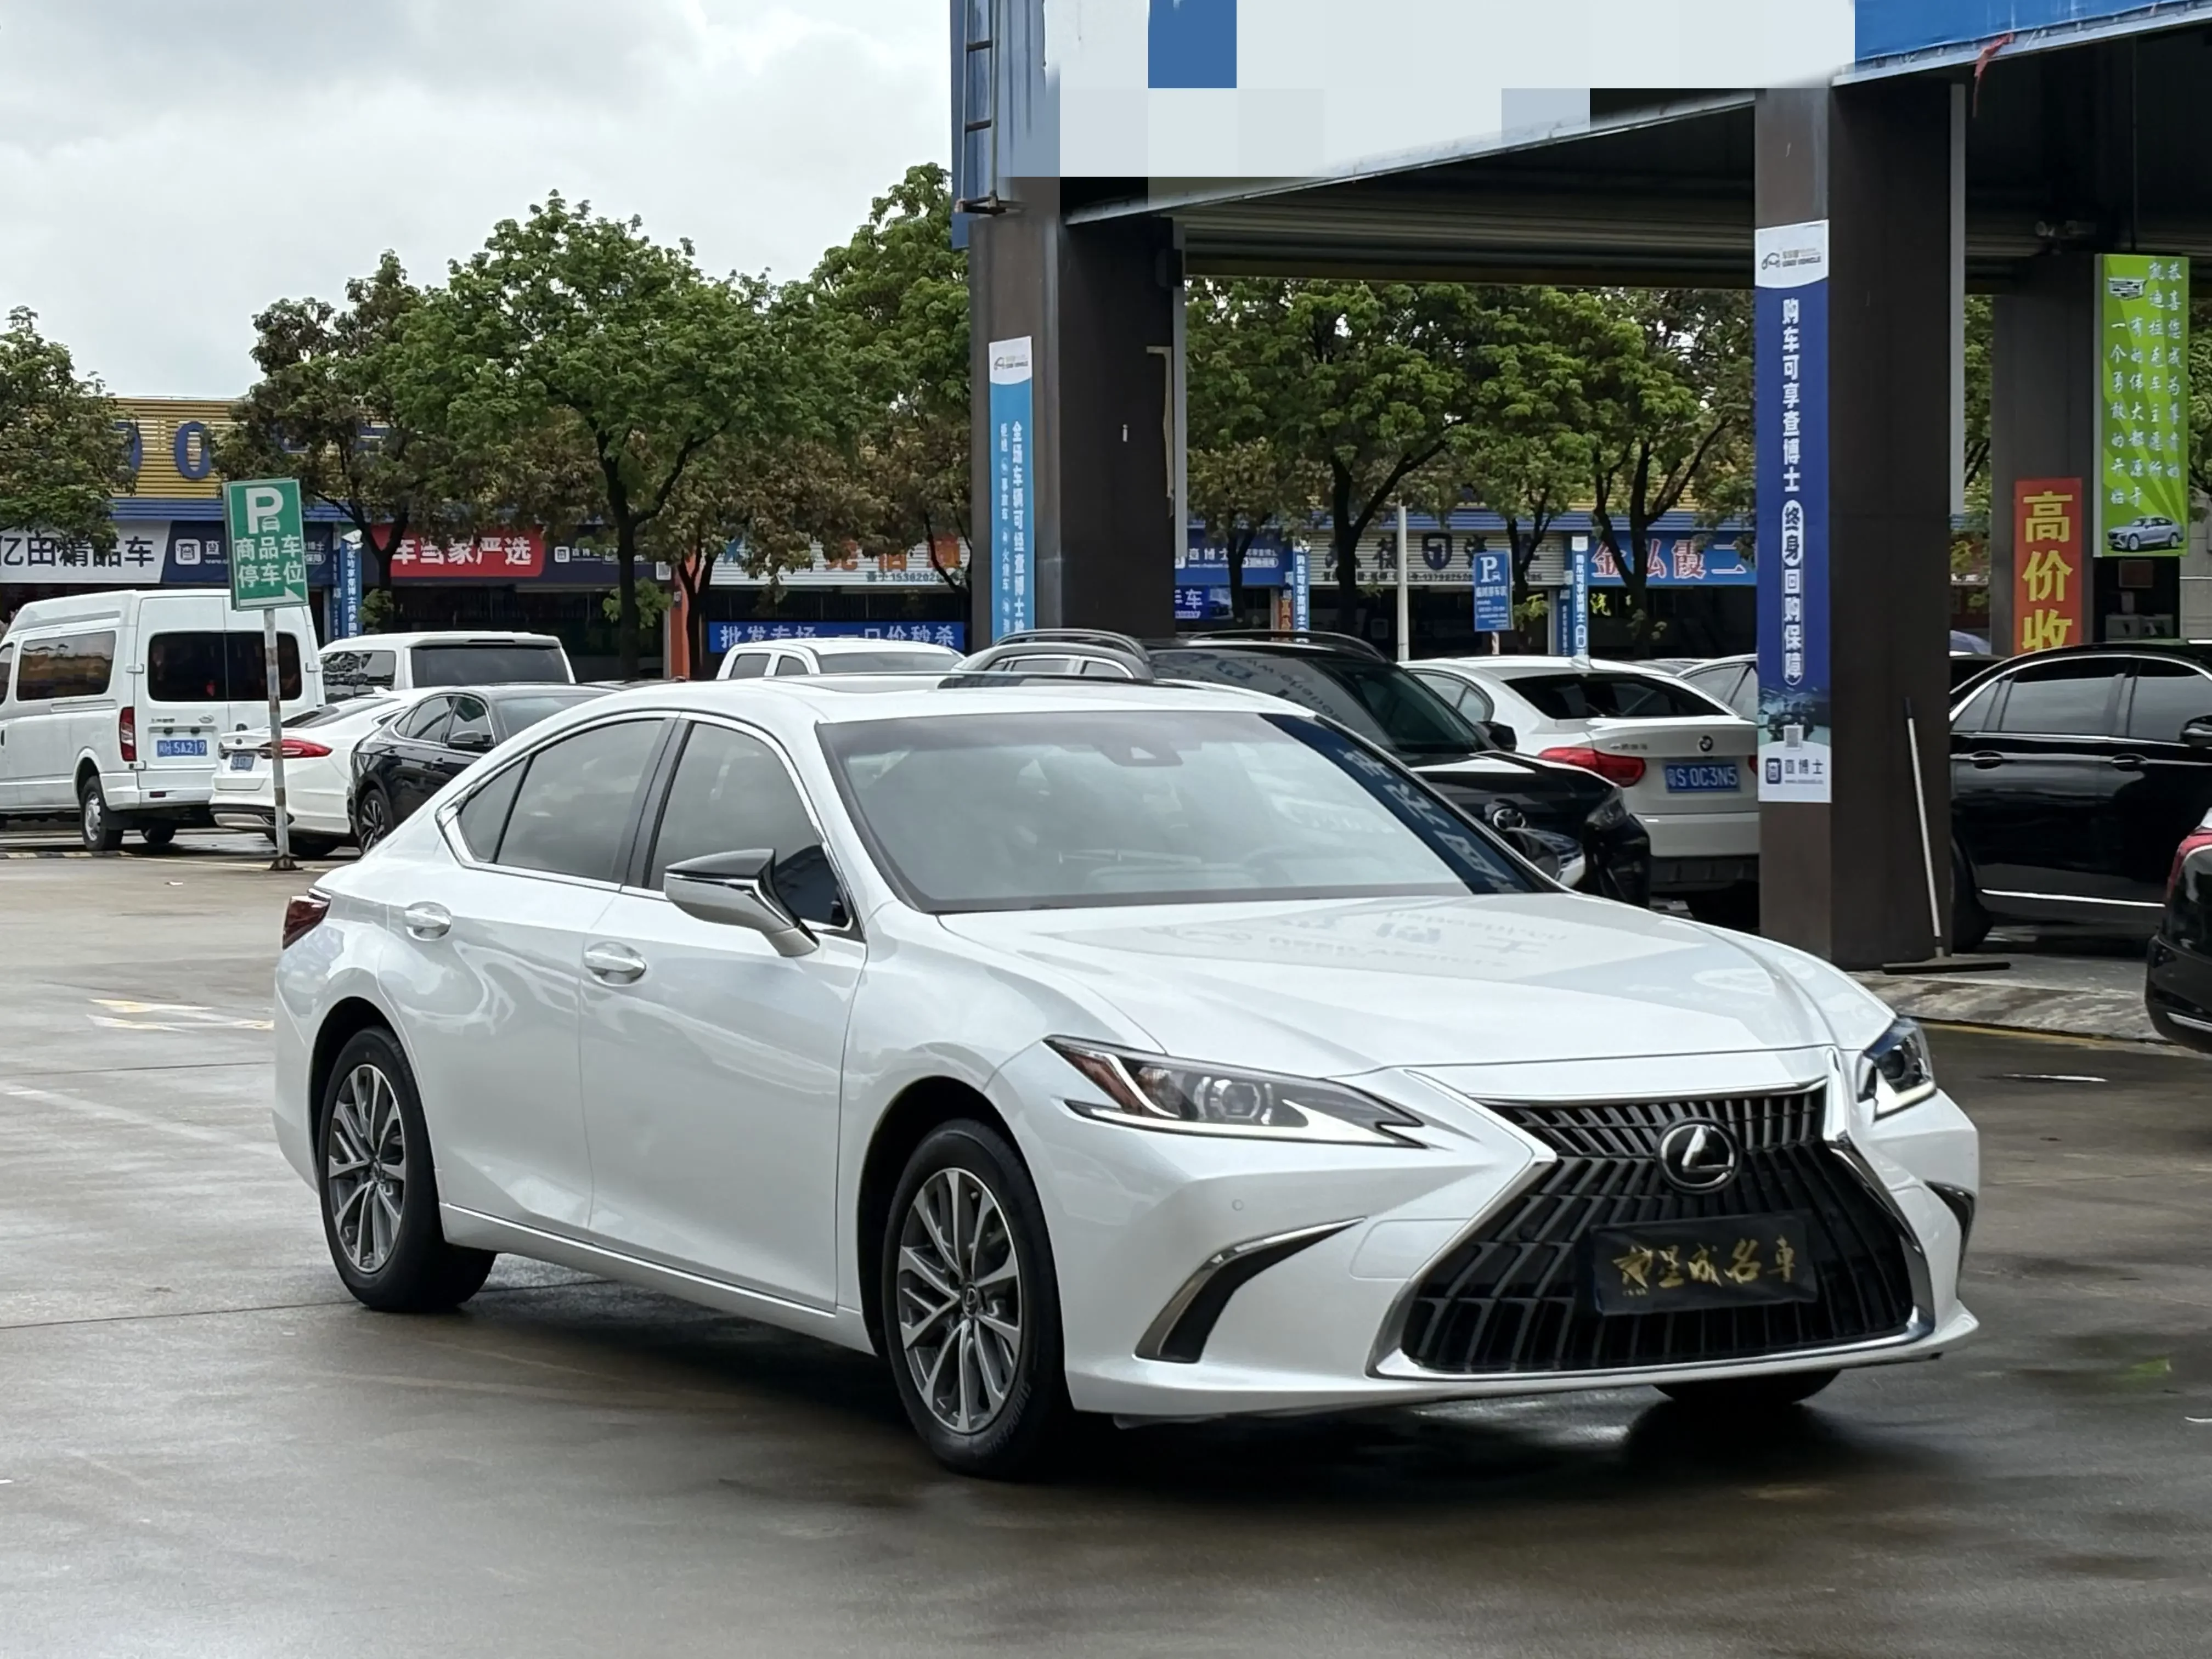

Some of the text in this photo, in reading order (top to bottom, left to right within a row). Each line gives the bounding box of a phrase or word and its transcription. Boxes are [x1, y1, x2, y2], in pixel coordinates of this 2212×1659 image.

[245, 487, 284, 534] P
[235, 534, 302, 562] 商品车
[392, 537, 531, 565] 车当家严选
[238, 560, 304, 589] 停车位
[1480, 556, 1497, 583] P
[2022, 490, 2073, 650] 高价收
